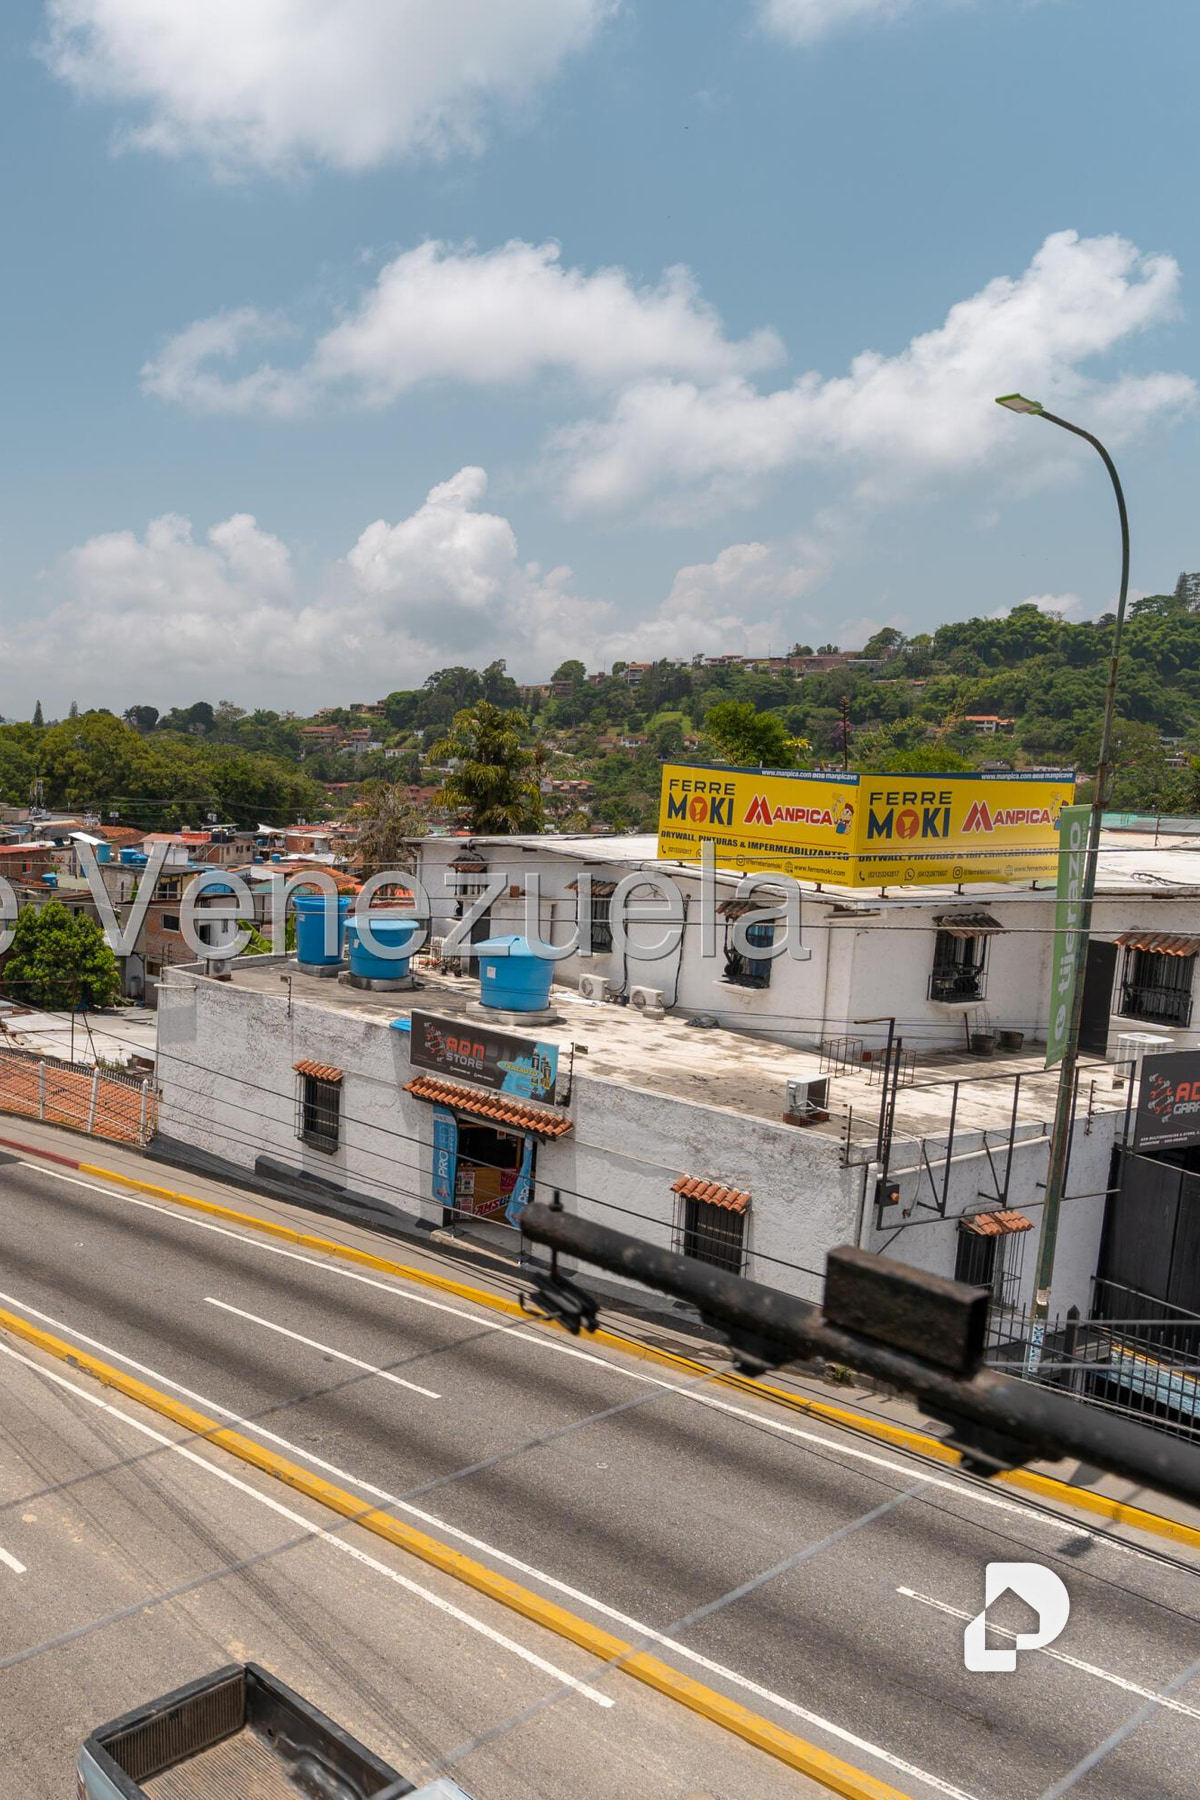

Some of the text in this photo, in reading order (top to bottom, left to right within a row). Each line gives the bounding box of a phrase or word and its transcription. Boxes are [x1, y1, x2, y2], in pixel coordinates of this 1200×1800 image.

[761, 769, 811, 779] www.manpica.com
[981, 772, 1032, 781] www.manpica.com
[669, 779, 736, 796] FERRE
[869, 791, 953, 806] FERRE
[667, 792, 734, 826] MOKI
[743, 793, 834, 826] MANPICA
[961, 800, 1053, 833] MANPICA
[867, 807, 950, 840] MOKI
[661, 829, 696, 842] DRYWALL,
[1057, 821, 1081, 996] tijerazo
[446, 1037, 487, 1060] ADN
[445, 1052, 484, 1070] STORE
